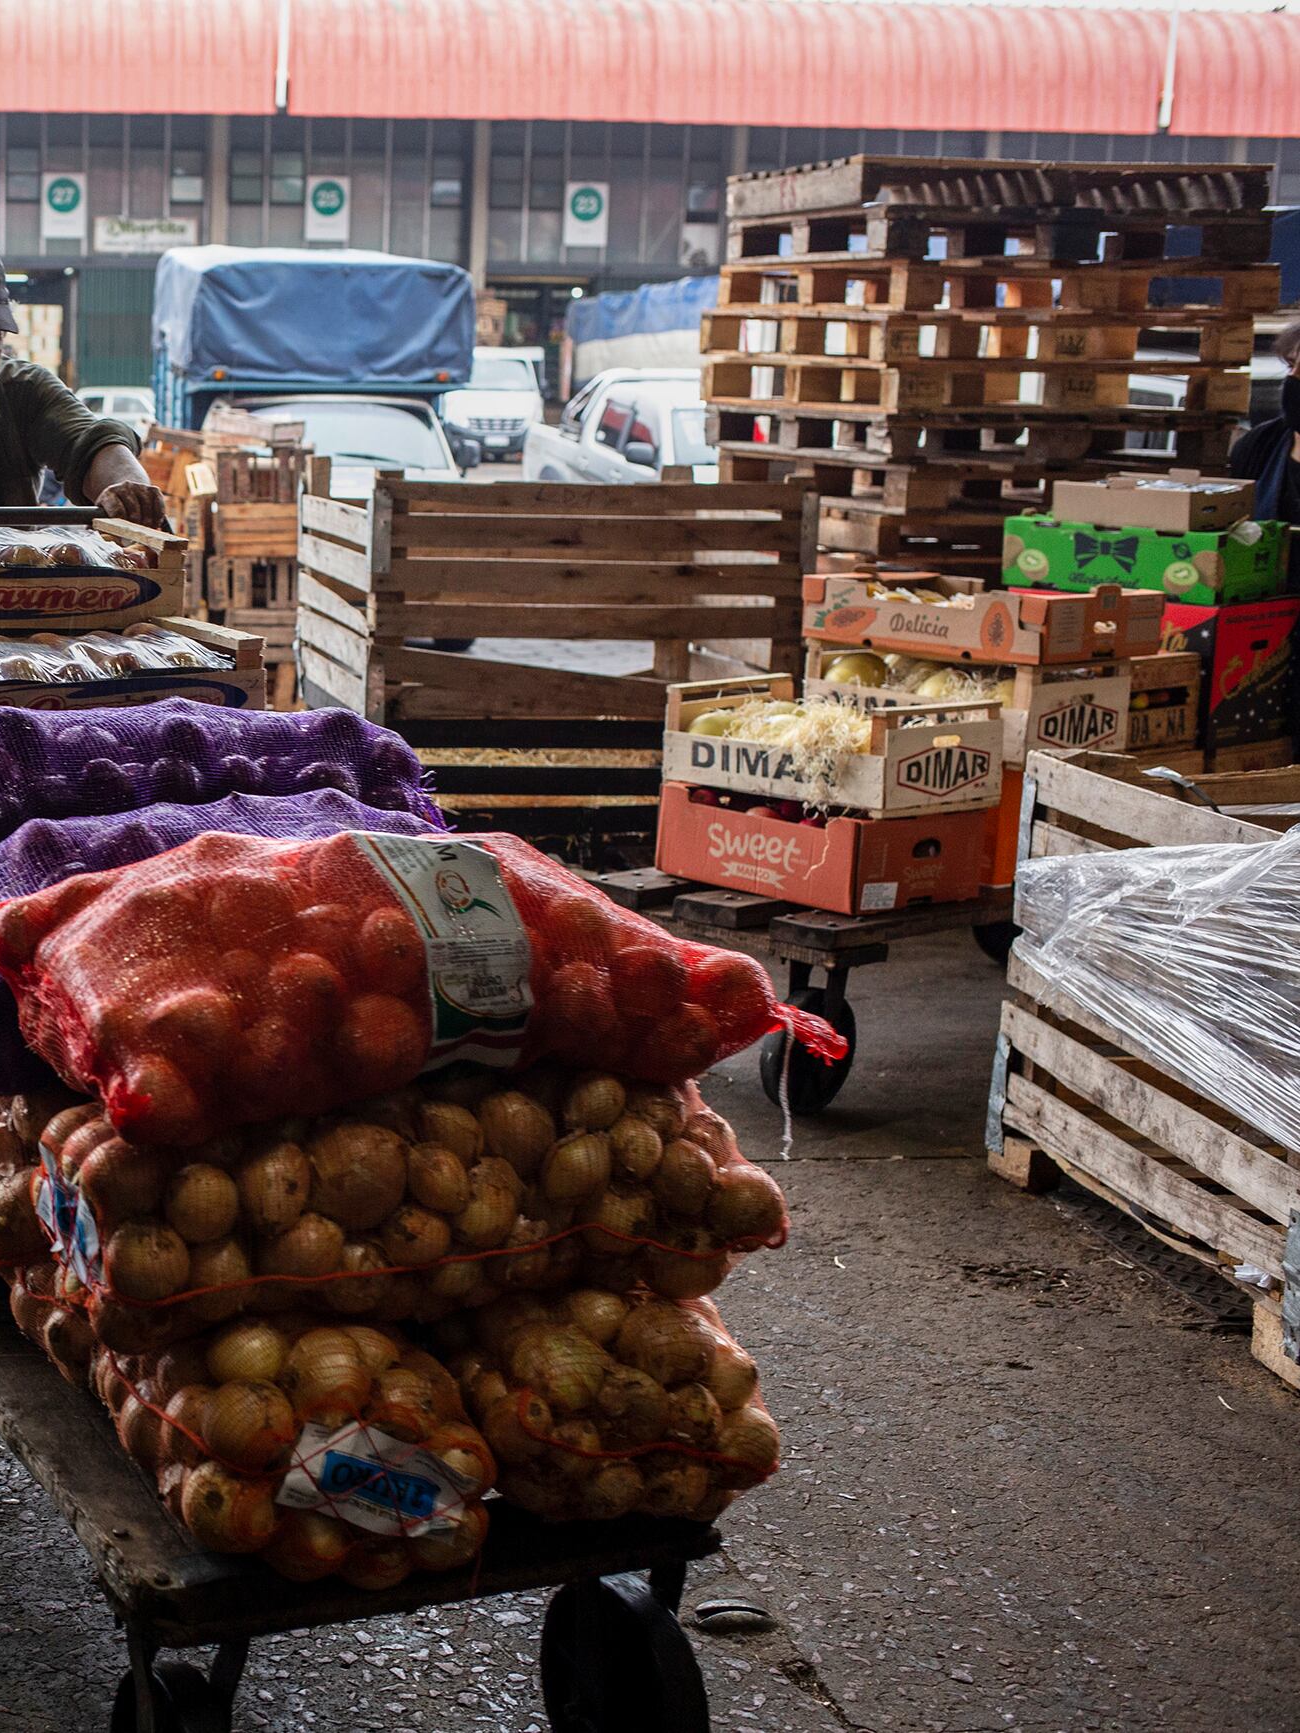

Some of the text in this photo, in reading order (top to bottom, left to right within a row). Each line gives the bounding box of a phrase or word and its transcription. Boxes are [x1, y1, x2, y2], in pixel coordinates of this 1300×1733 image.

[890, 613, 949, 639] Delicia
[1043, 702, 1115, 745] DIMAR
[691, 741, 837, 788] DIMA
[906, 748, 989, 790] DIMAR
[708, 822, 801, 874] Sweet
